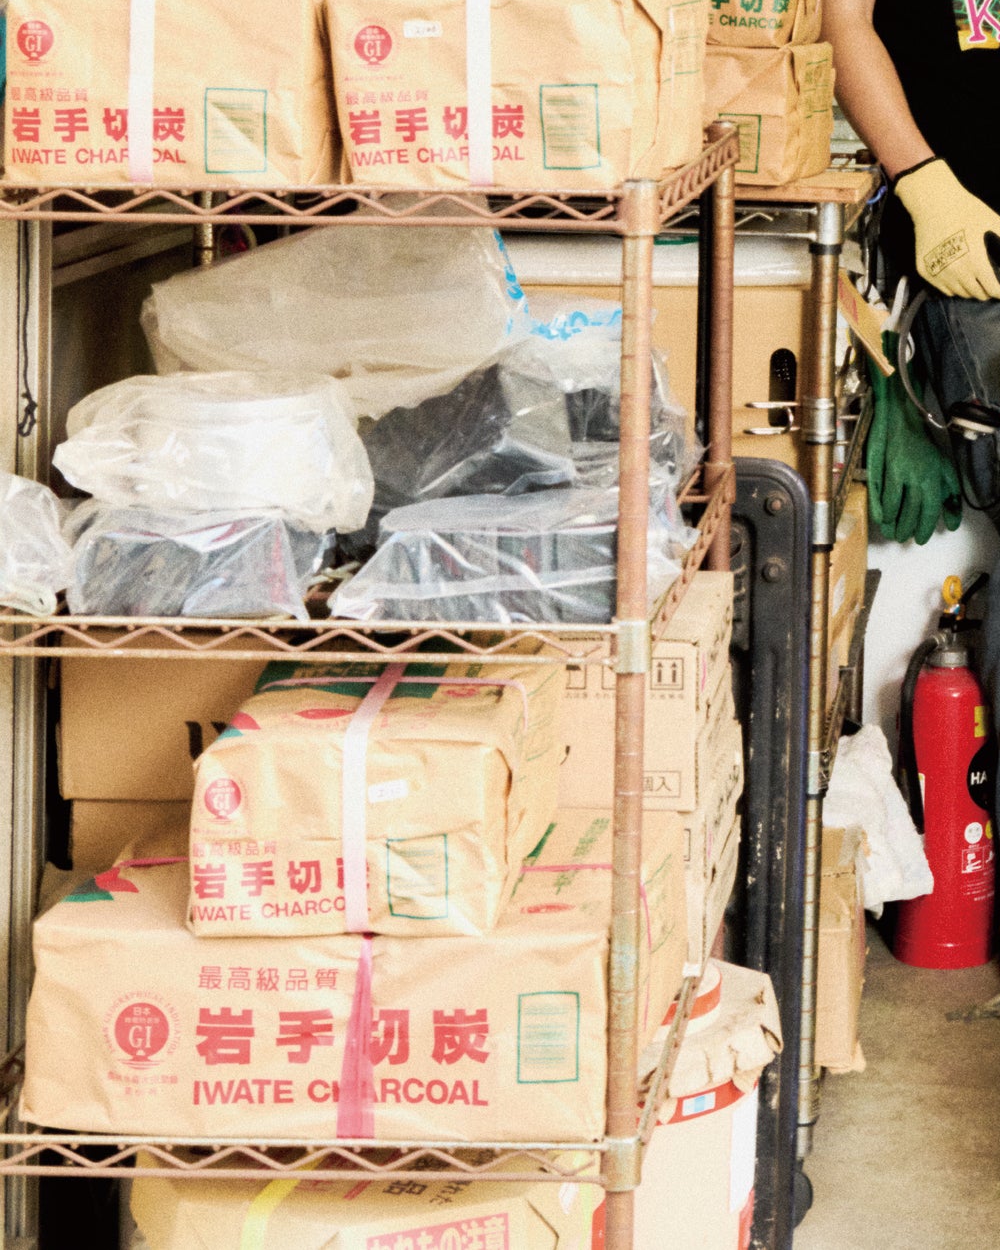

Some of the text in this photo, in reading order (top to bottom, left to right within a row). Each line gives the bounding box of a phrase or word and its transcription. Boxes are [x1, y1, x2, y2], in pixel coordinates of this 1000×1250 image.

[25, 35, 43, 52] GI
[363, 41, 381, 57] GI
[198, 965, 339, 992] 最高級品質
[128, 1025, 153, 1048] GI
[195, 1007, 490, 1066] 岩手切炭
[193, 1079, 294, 1105] IWATE
